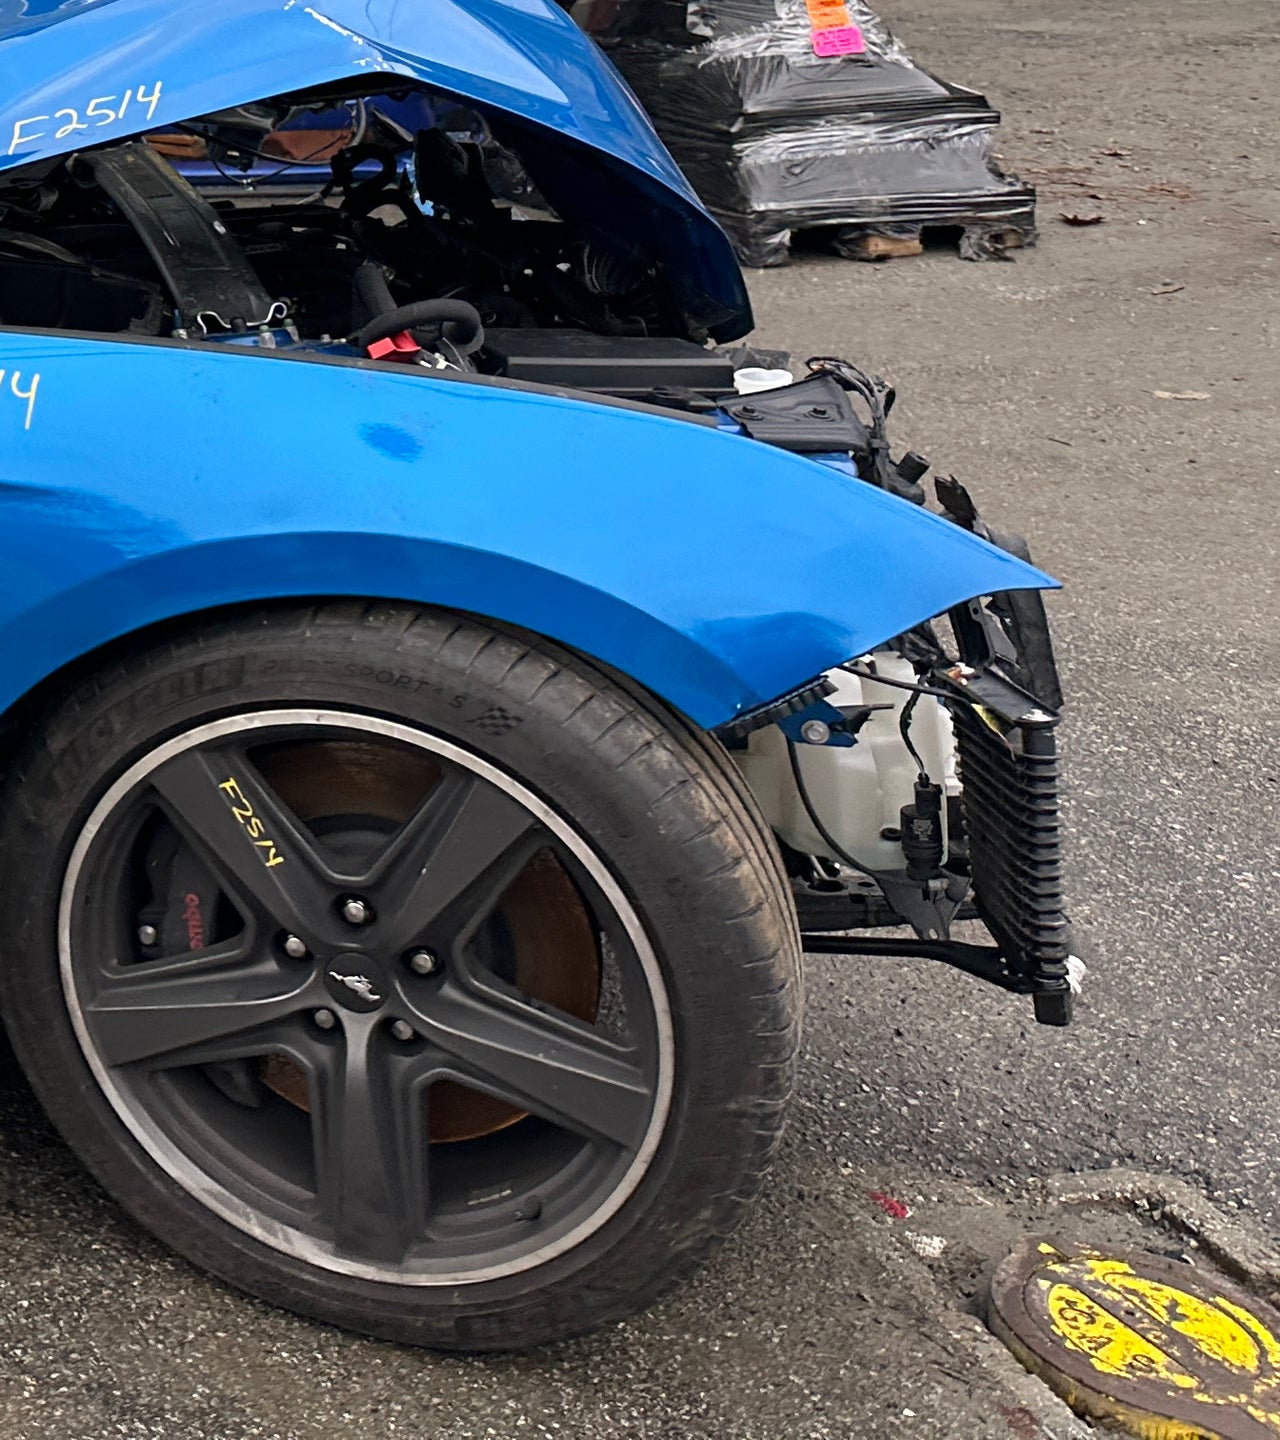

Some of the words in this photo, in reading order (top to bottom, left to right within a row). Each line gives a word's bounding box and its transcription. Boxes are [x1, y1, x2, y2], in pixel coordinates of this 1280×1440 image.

[6, 79, 164, 156] F2514
[344, 662, 429, 693] SPORT
[218, 776, 285, 868] F2514
